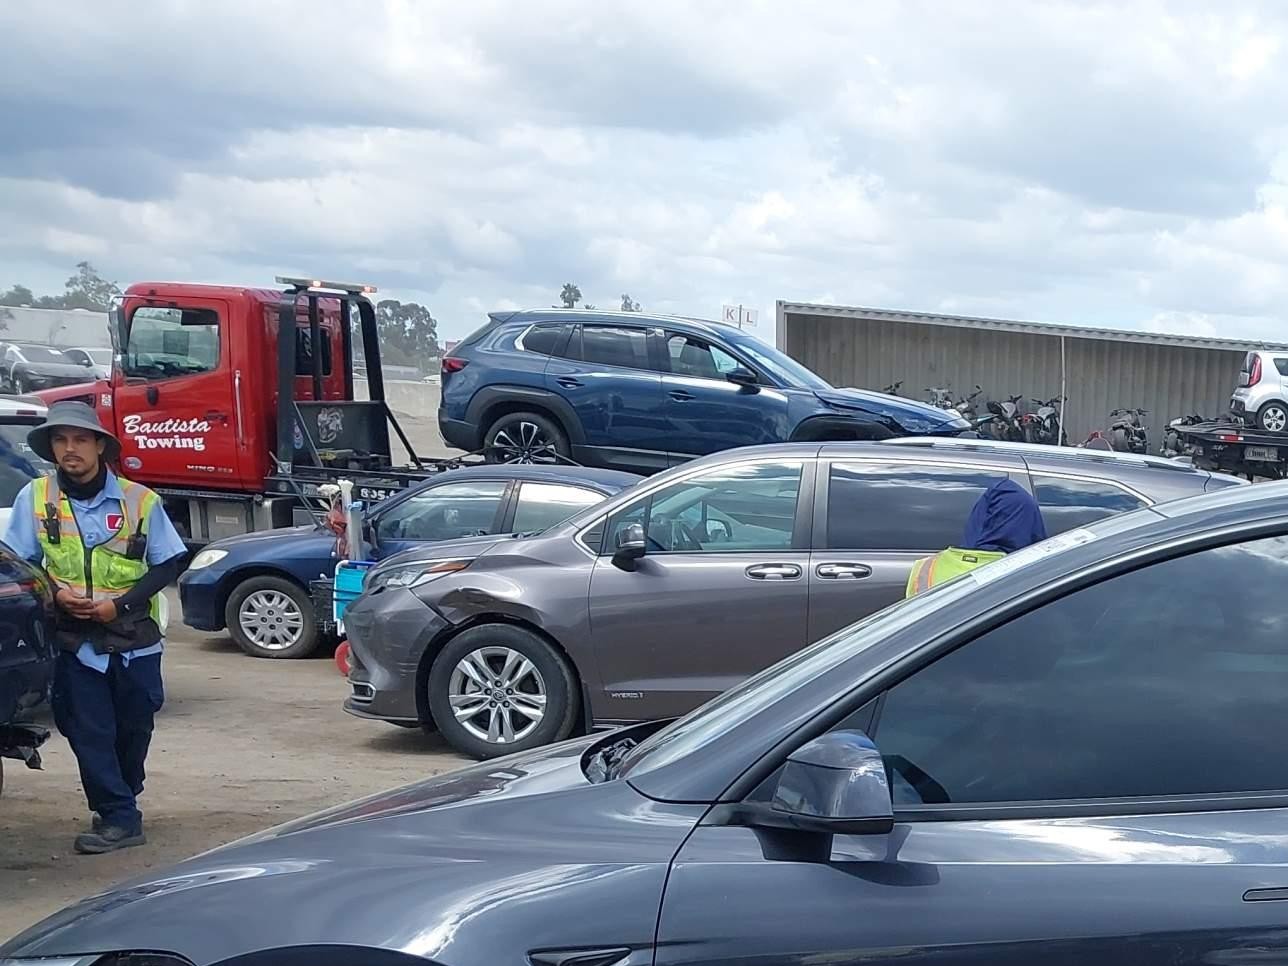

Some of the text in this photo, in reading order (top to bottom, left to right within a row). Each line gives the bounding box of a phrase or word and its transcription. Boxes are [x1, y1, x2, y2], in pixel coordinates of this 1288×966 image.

[726, 308, 735, 320] K
[746, 311, 753, 323] L
[123, 415, 211, 434] Bautista
[134, 434, 205, 451] Towing
